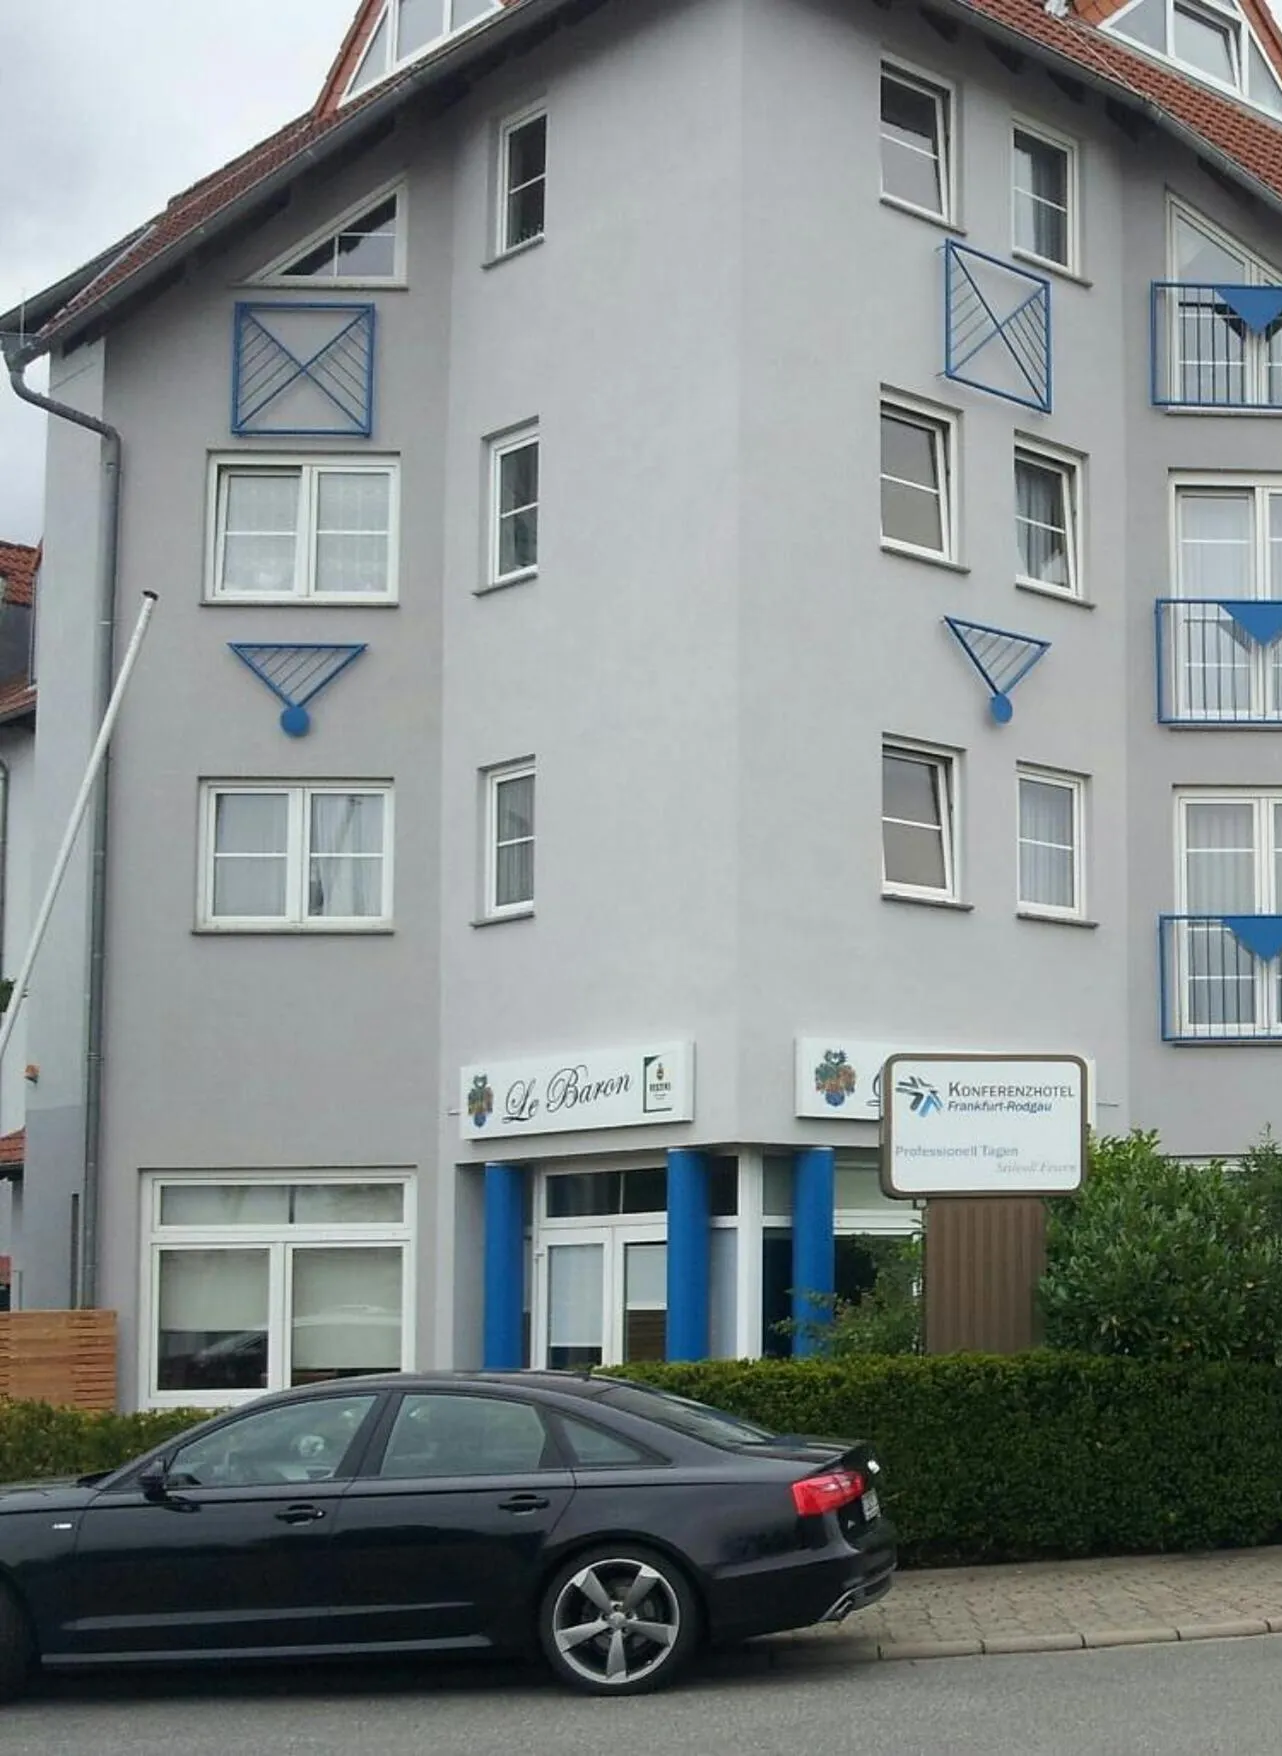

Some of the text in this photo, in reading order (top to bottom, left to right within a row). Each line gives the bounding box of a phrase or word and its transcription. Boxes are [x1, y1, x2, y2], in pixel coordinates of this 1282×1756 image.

[502, 1064, 633, 1124] Le Baron
[948, 1081, 1076, 1098] KONFERENZHOTEL
[947, 1100, 1053, 1114] Frankfurt-Rodgau
[895, 1144, 1018, 1159] Professionell Tagen
